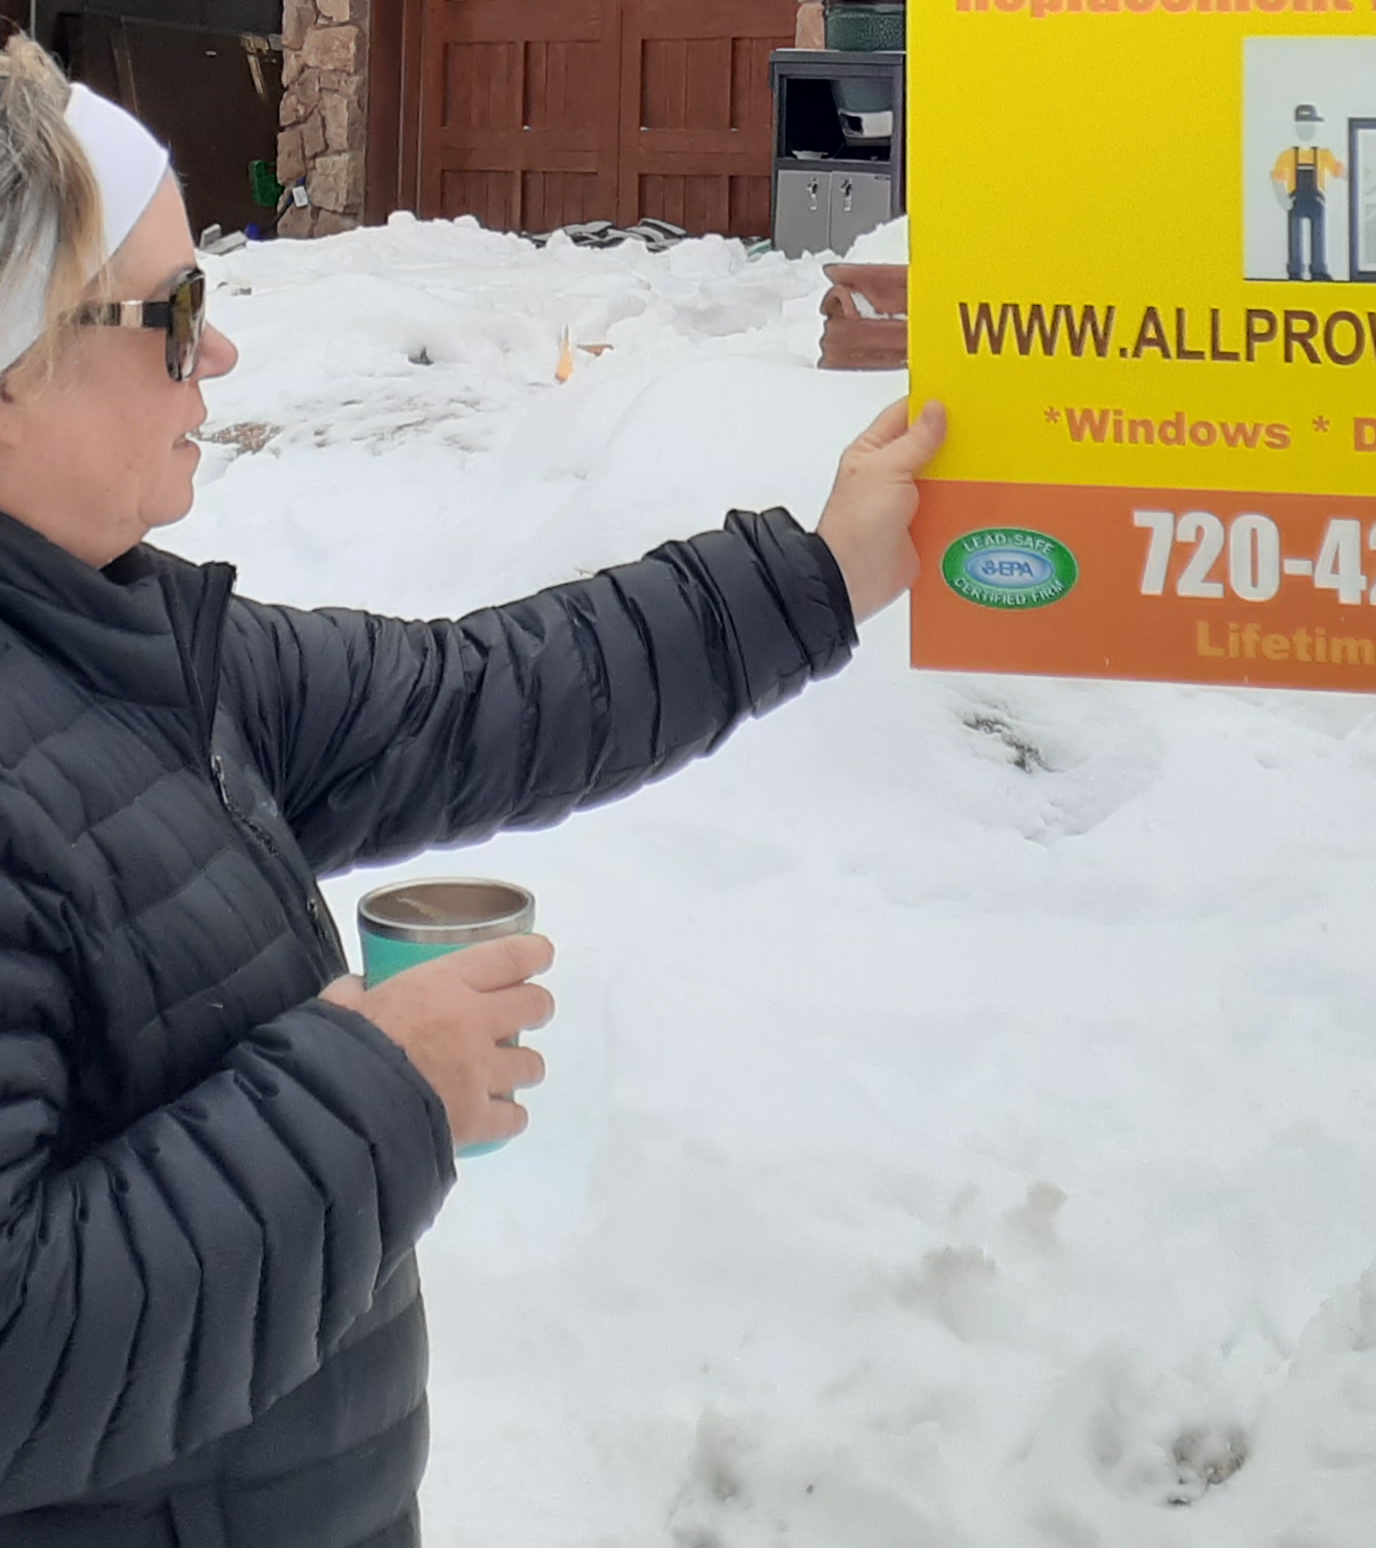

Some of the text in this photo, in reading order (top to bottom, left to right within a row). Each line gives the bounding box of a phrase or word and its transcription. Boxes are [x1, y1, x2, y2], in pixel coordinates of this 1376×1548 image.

[998, 560, 1035, 578] EPA
[954, 577, 1066, 606] CERTIFIED FIRM
